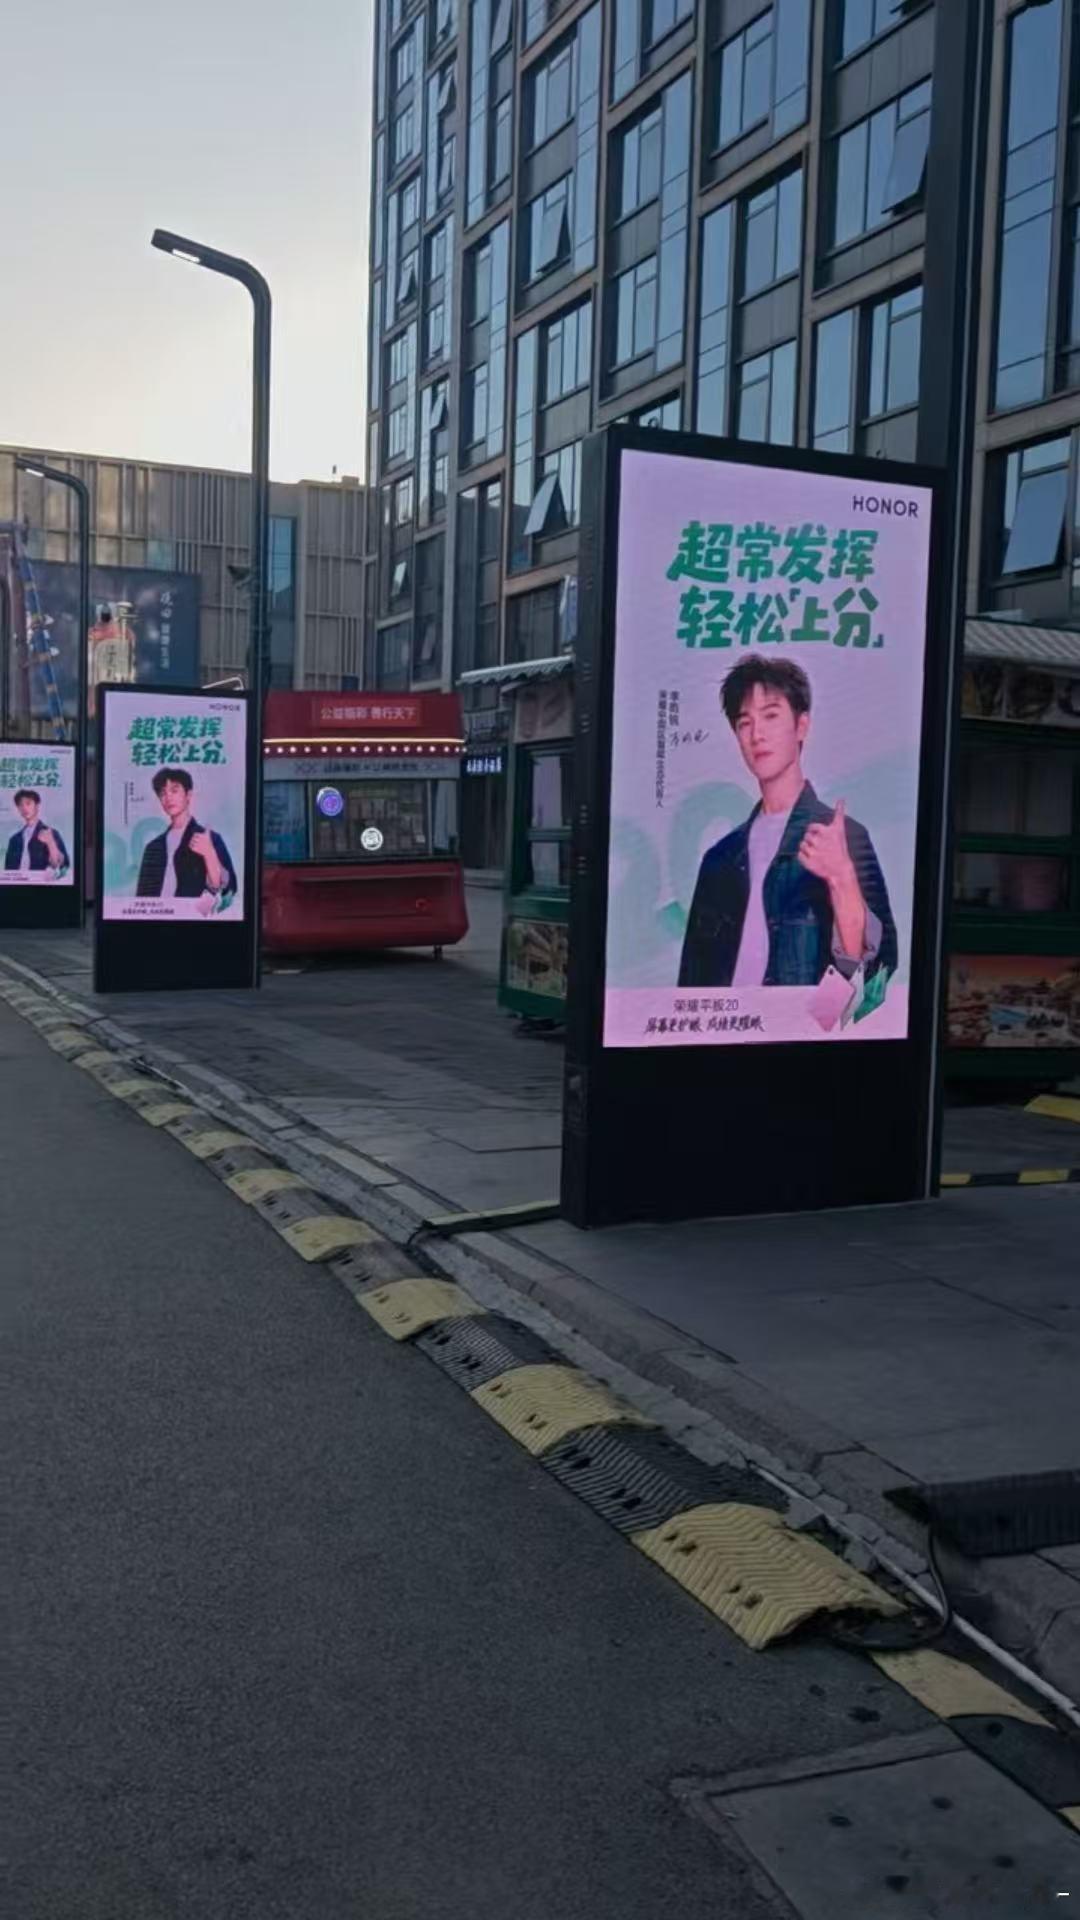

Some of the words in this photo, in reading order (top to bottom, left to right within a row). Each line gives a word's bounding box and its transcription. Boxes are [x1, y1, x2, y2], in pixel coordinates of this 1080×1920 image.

[852, 495, 918, 518] HONOR
[666, 520, 879, 583] 超常发挥
[128, 715, 223, 740] 超常发挥
